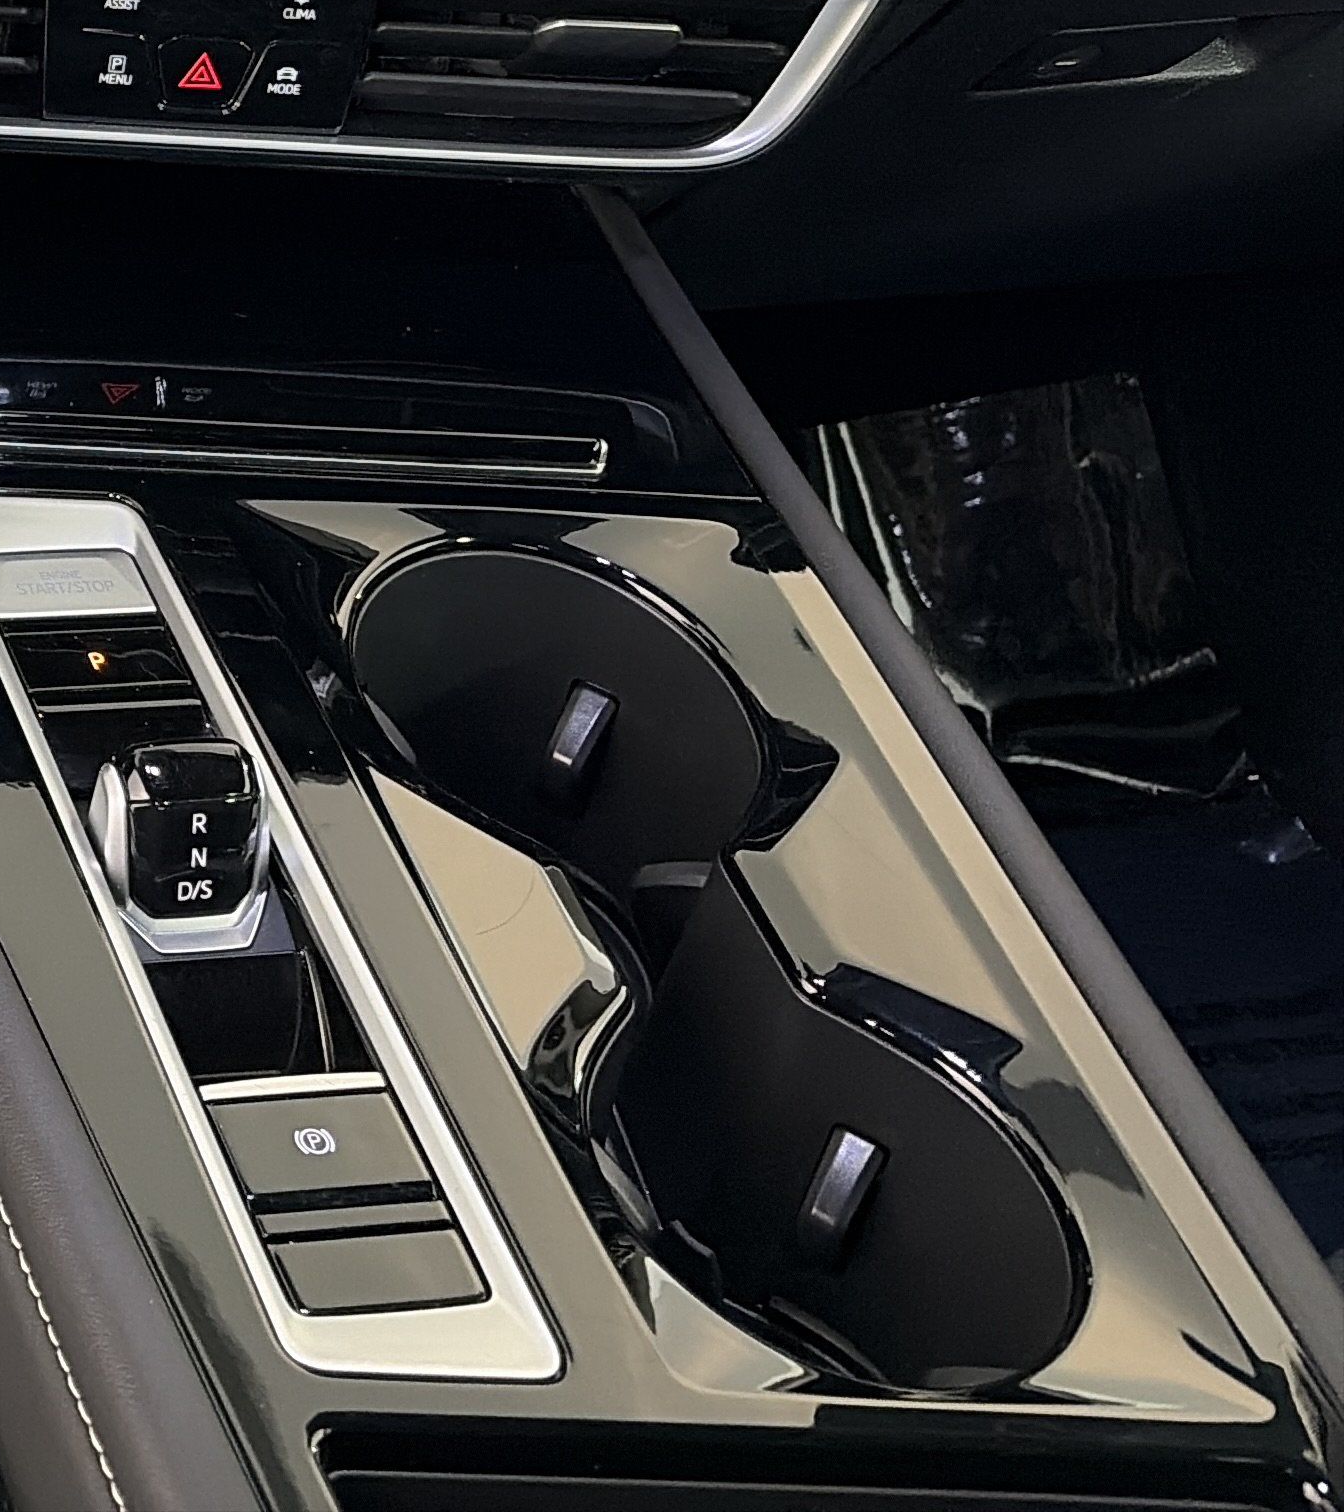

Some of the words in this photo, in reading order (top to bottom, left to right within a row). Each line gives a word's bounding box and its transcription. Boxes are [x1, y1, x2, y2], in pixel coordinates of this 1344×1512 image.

[282, 7, 317, 21] CLIMA
[98, 73, 133, 86] MENU
[267, 83, 302, 96] MODE
[16, 579, 115, 596] START/STOP
[87, 651, 107, 672] P
[192, 813, 207, 835] R
[191, 847, 208, 868] N
[177, 879, 213, 901] D/S
